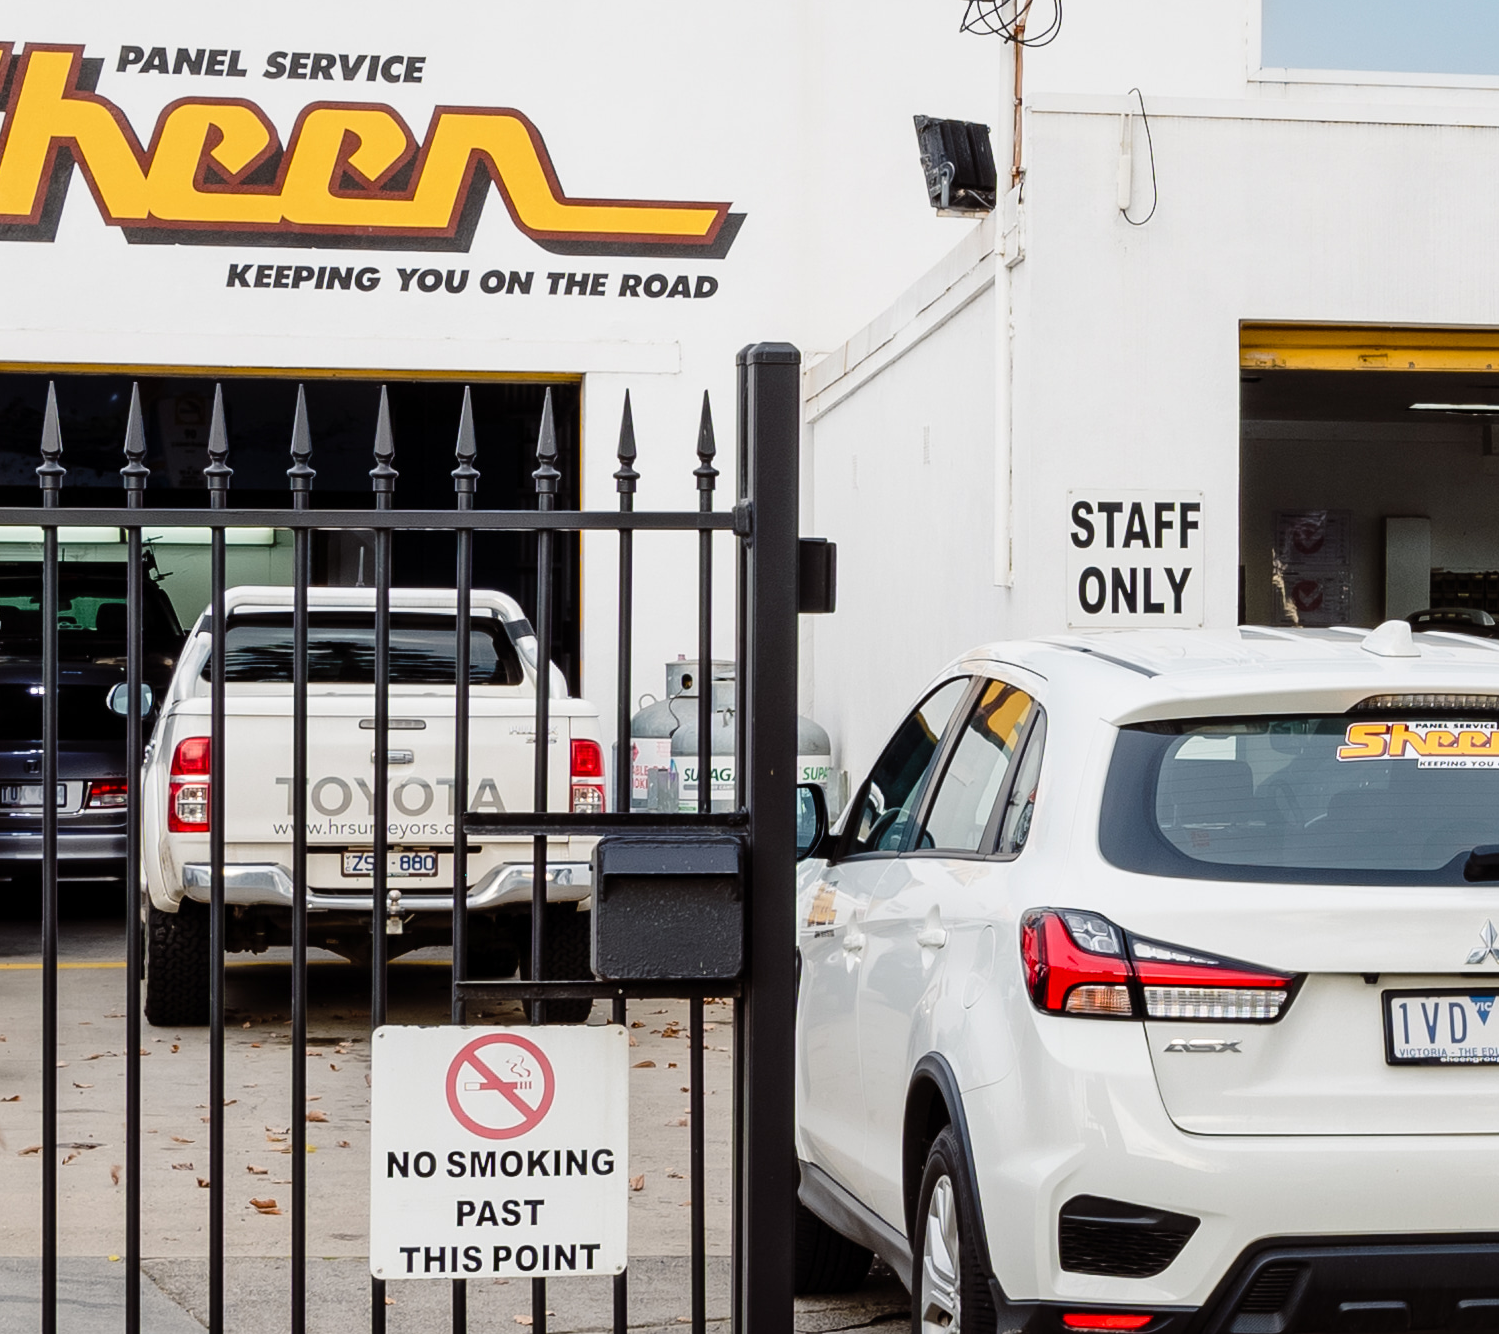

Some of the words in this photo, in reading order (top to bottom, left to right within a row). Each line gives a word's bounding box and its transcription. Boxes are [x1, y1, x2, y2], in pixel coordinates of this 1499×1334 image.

[116, 45, 249, 79] PANEL
[262, 50, 427, 84] SERVICE
[225, 262, 381, 292] KEEPING
[395, 266, 467, 294] YOU
[476, 267, 534, 295] ON
[545, 270, 610, 297] THE
[618, 272, 719, 300] ROAD
[1070, 500, 1201, 549] STAFF
[1078, 566, 1192, 614] ONLY
[1419, 760, 1469, 768] KEEPING
[1471, 760, 1494, 768] YOU
[1473, 1002, 1493, 1012] VIC
[1399, 1002, 1468, 1045] 1VD
[1163, 1038, 1243, 1053] ASX
[1400, 1048, 1448, 1057] VICTORIA
[1458, 1047, 1479, 1056] THE
[387, 1150, 436, 1178] NO
[445, 1147, 616, 1178] SMOKING
[455, 1198, 545, 1228] PAST
[400, 1245, 483, 1273] THIS
[491, 1242, 601, 1272] POINT
